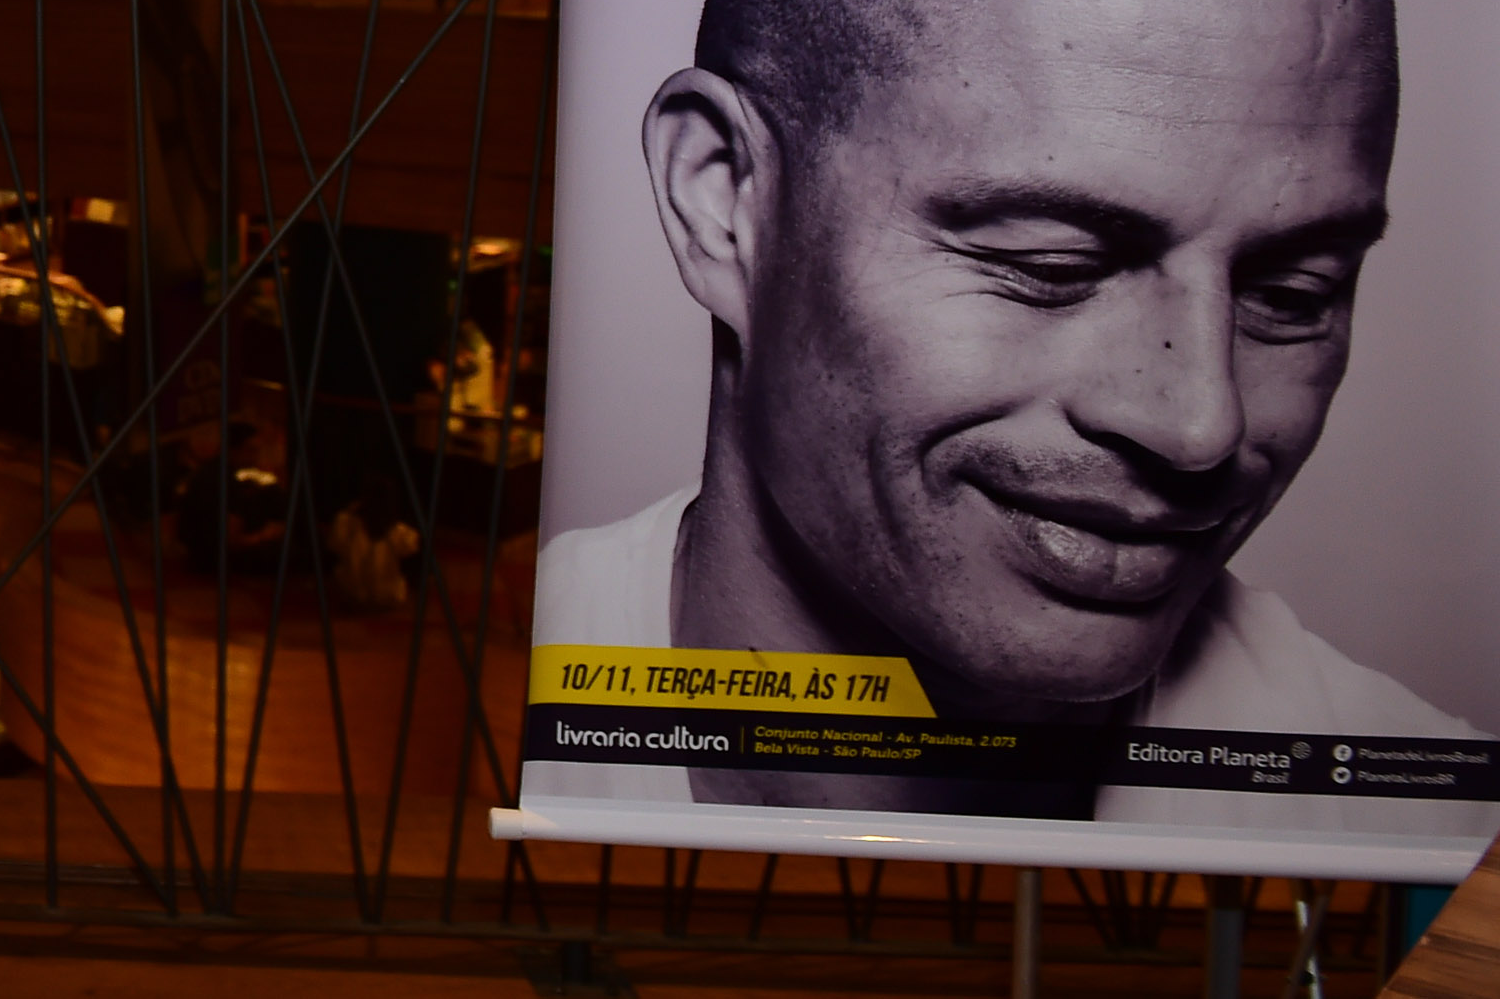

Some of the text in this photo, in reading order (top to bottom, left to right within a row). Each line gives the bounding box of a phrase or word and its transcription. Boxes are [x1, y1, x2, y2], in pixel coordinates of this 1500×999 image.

[562, 664, 891, 702] 10/11, TERÇA-FEIRA, ÀS 17H
[556, 720, 730, 752] livraria cultura
[753, 724, 819, 741] Conjunto
[822, 729, 884, 743] Nacional
[895, 731, 915, 744] Av.
[919, 732, 976, 748] Paulista,
[980, 735, 1018, 749] 2.073
[753, 741, 784, 754] Bela
[786, 742, 820, 757] Vista
[833, 744, 858, 758] São
[861, 746, 923, 760] Paulo/SP
[1127, 742, 1292, 770] Editora Planeta
[1251, 771, 1291, 785] Brasil
